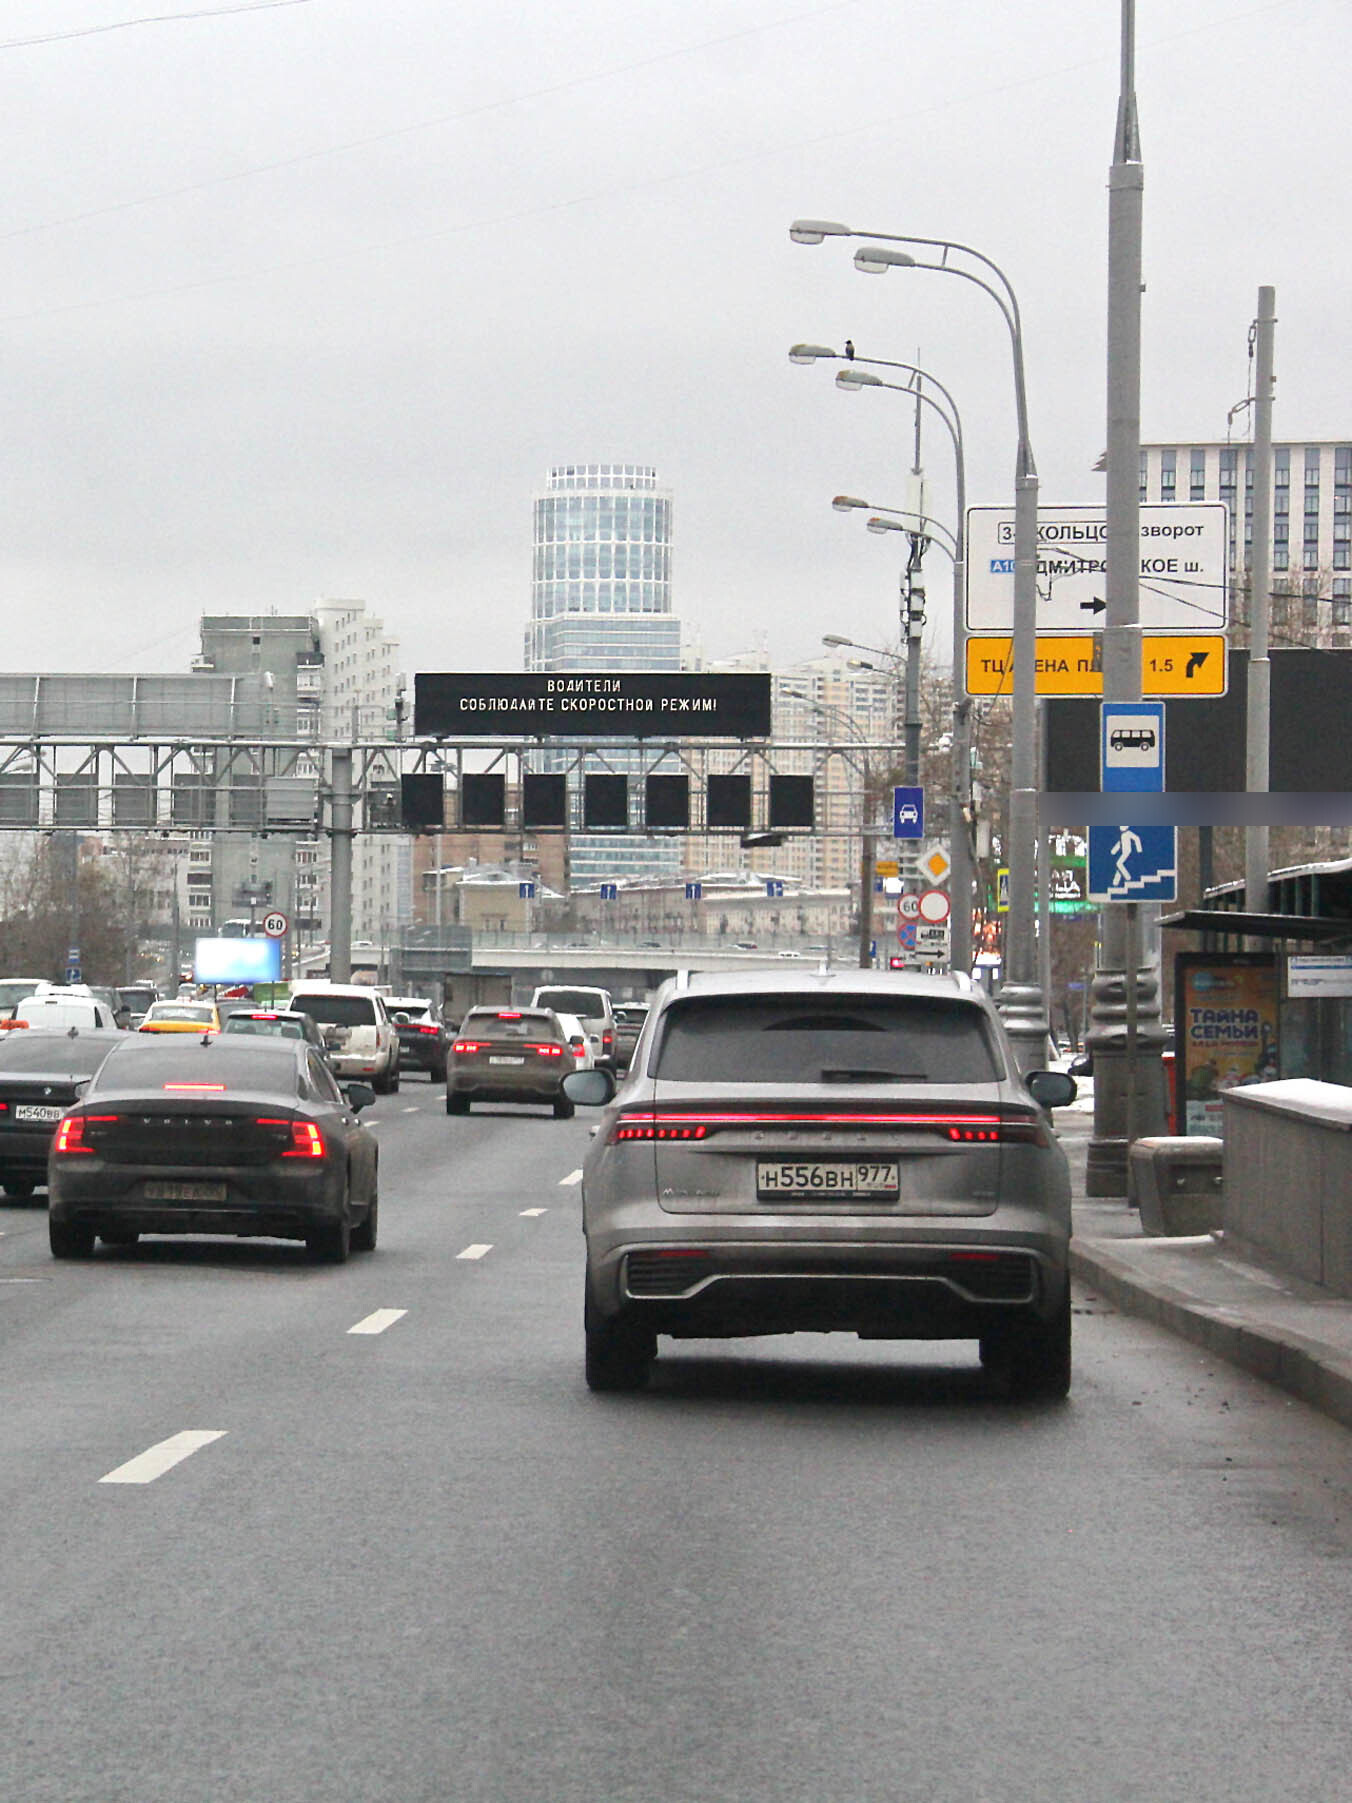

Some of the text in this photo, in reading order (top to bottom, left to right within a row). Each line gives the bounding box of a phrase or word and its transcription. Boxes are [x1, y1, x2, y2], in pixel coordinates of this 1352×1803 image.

[1002, 526, 1015, 540] 3-
[1141, 525, 1205, 540] зворот
[1184, 561, 1204, 573] ш.
[981, 659, 1005, 675] ТЦ
[1149, 659, 1174, 672] 1.5
[547, 679, 621, 693] ВОДИТЕЛИ
[459, 697, 717, 711] СОБЛЮДАЙТЕ СКОРОСТНОЙ РЕЖИМ!
[903, 901, 918, 912] 60
[268, 919, 283, 930] 60
[1190, 1008, 1259, 1023] ТАЙНА
[1190, 1024, 1259, 1040] СЕМЬИ
[765, 1165, 892, 1188] Н556ВН 977
